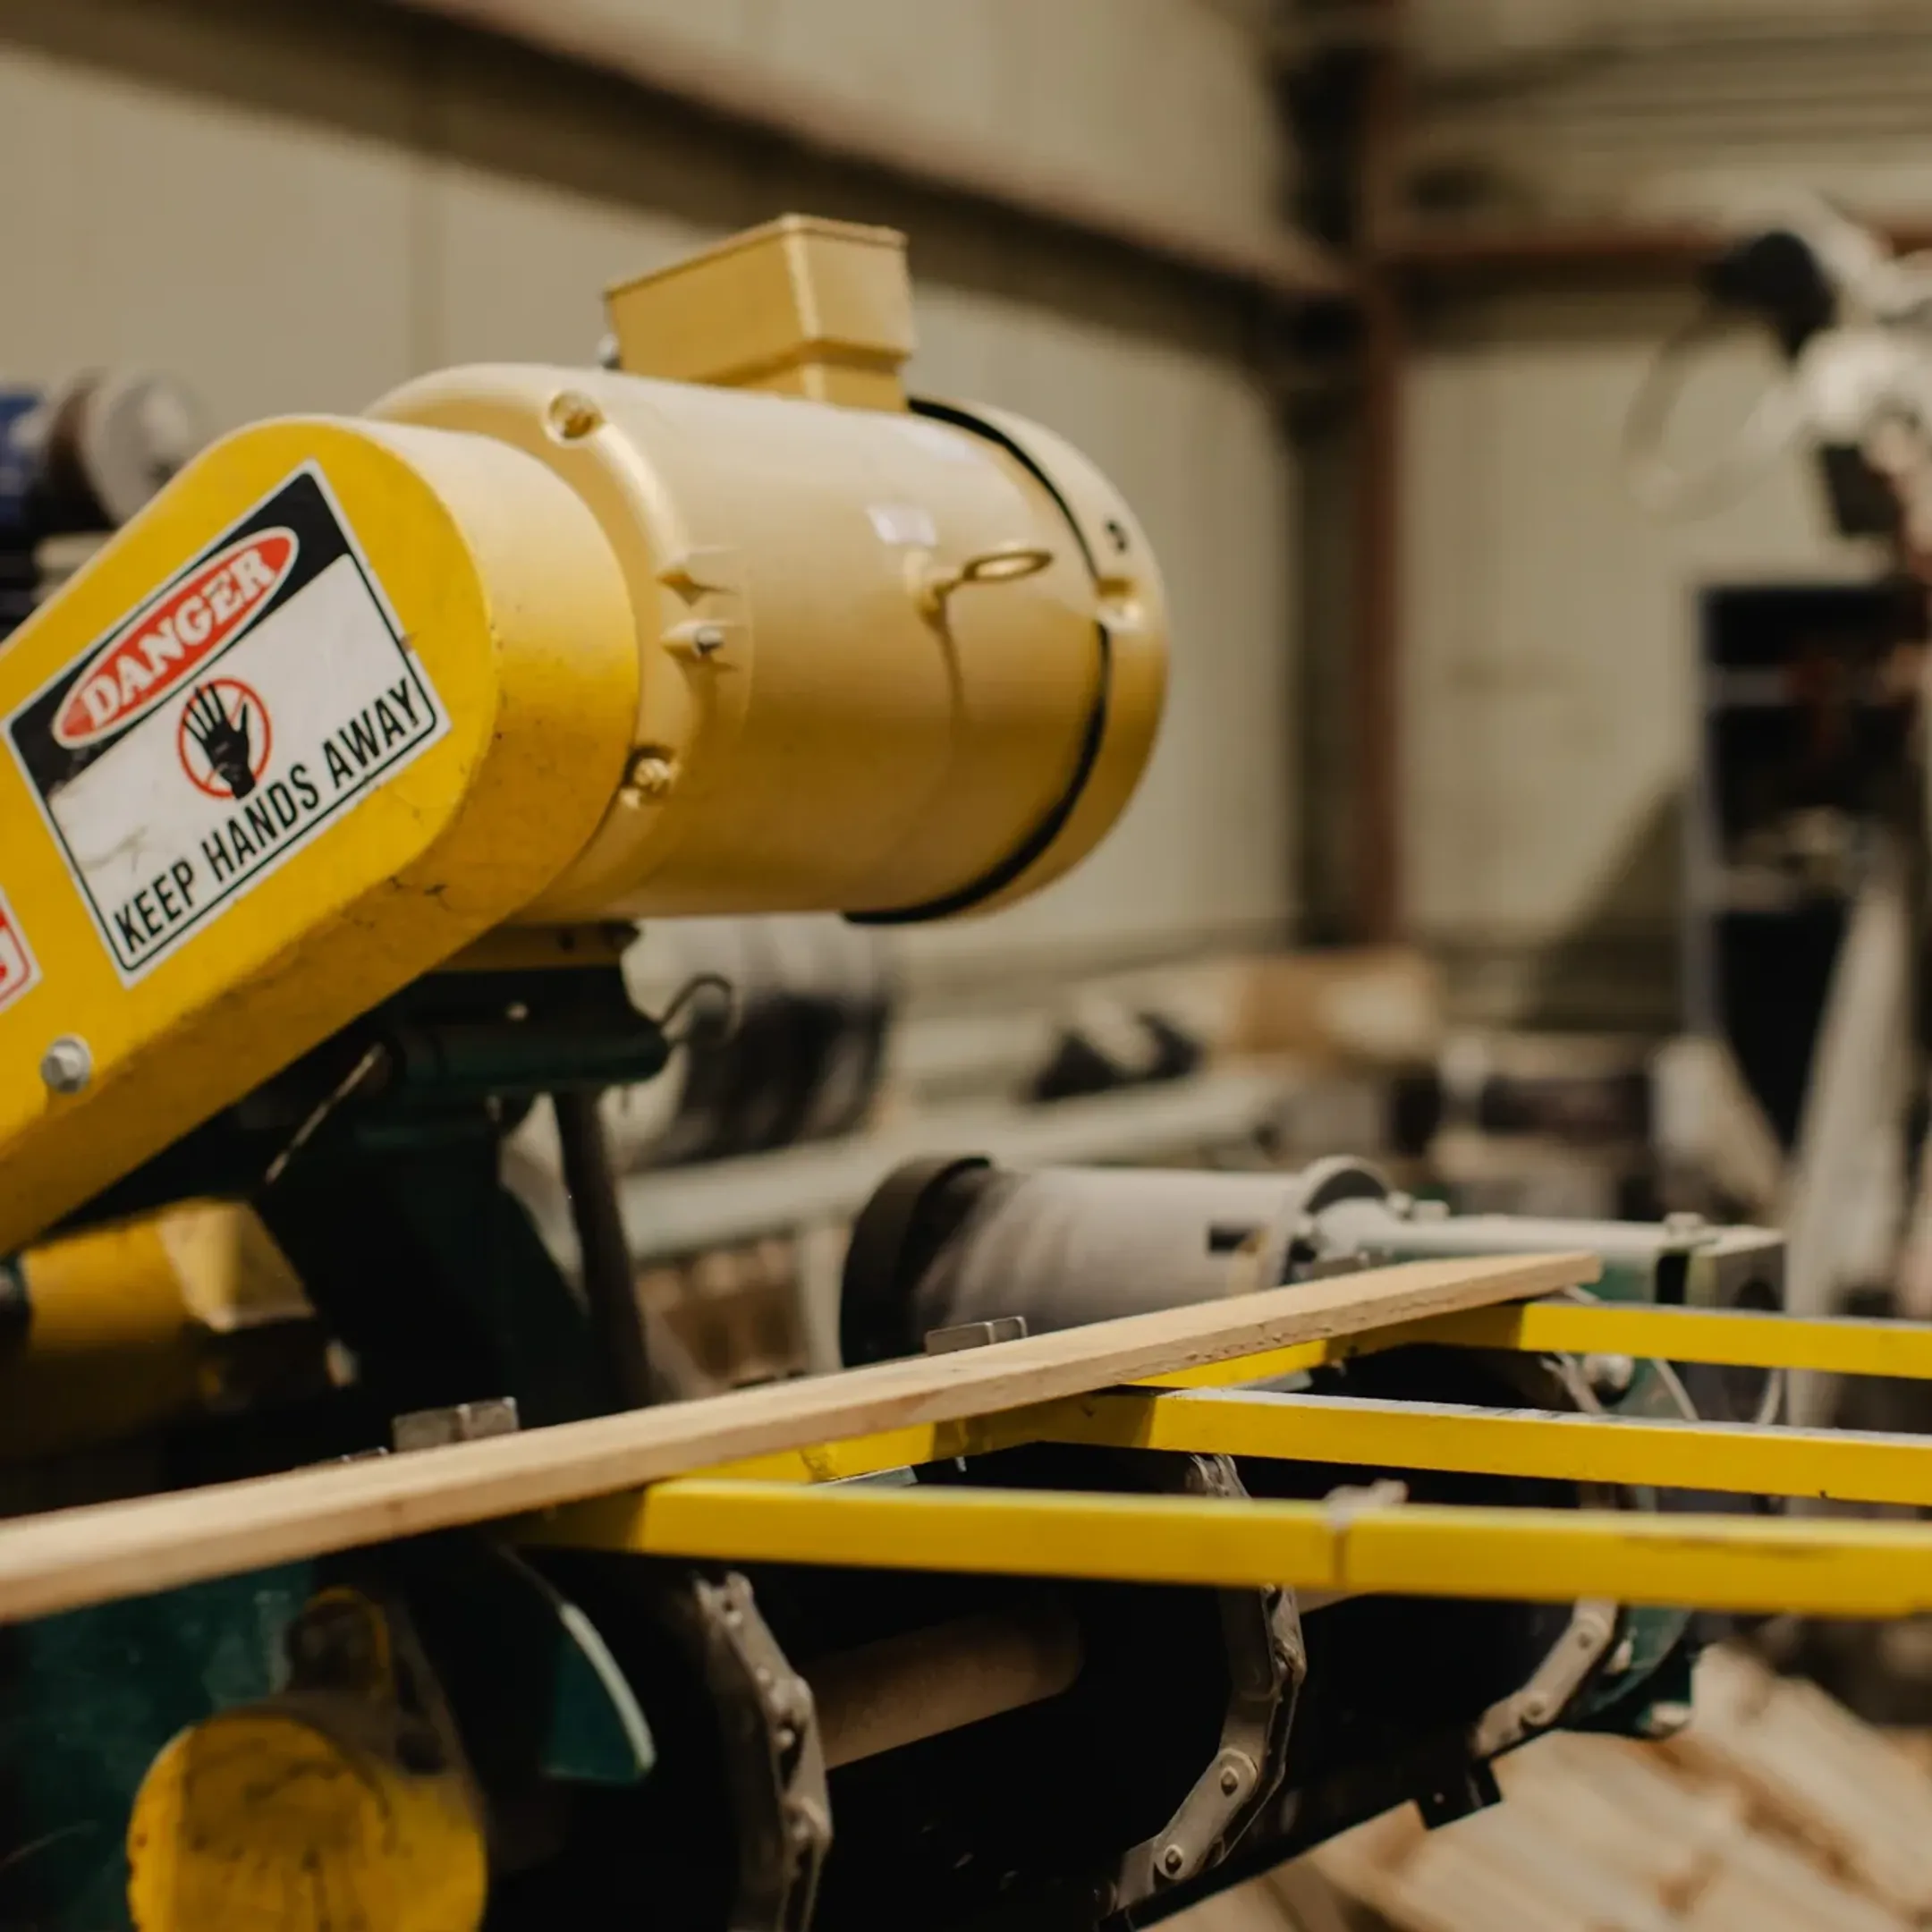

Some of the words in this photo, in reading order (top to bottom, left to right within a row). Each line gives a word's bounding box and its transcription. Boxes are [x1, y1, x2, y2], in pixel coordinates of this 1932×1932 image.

[81, 548, 276, 726] DANGER
[114, 860, 196, 954] KEEP
[201, 764, 320, 883] HANDS
[321, 678, 420, 789] AWAY
